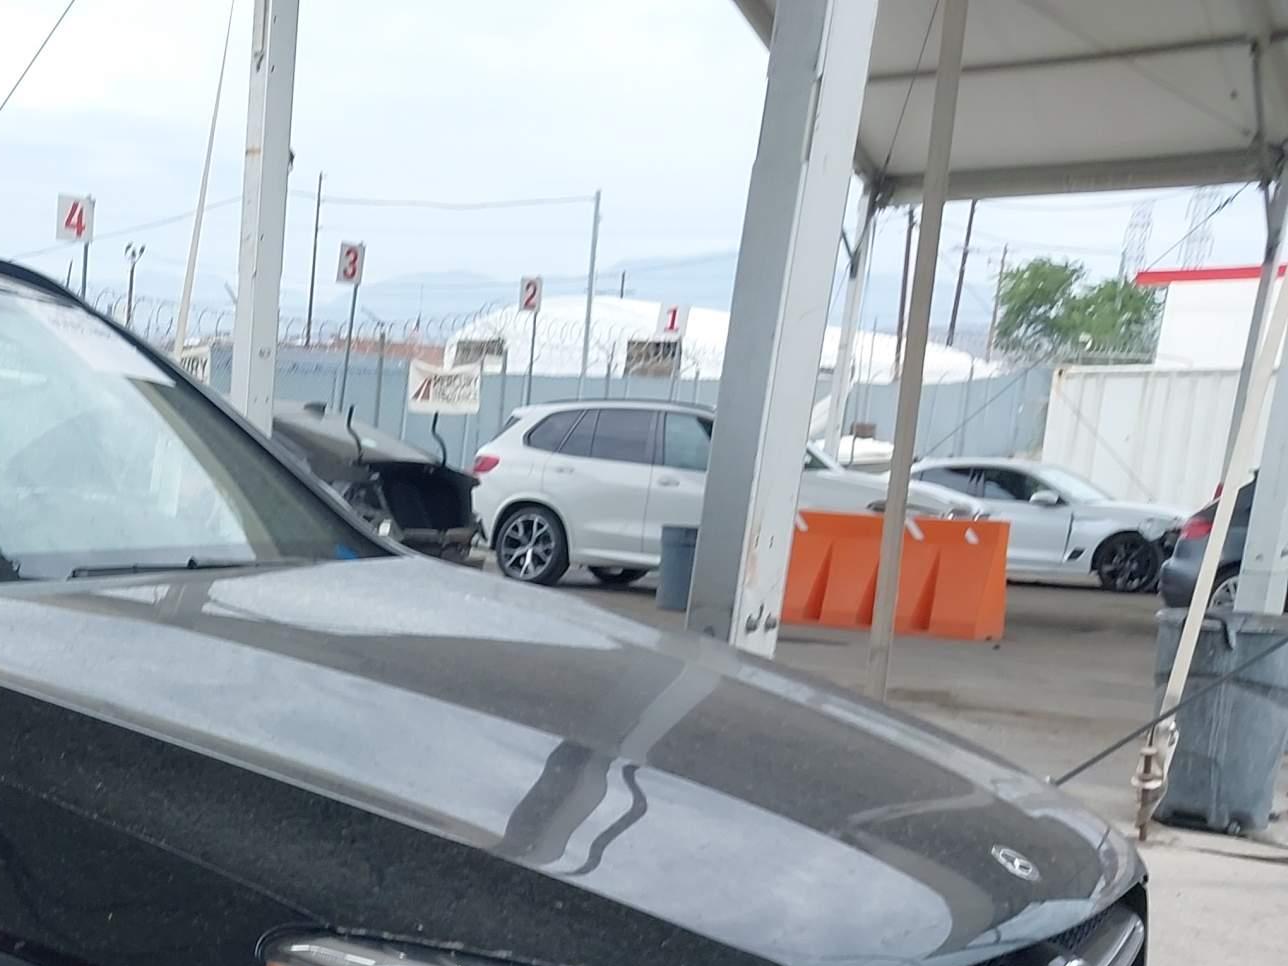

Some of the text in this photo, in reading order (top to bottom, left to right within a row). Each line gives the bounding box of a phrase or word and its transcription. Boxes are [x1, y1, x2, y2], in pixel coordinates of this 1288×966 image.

[65, 202, 86, 238] 4
[342, 247, 359, 280] 3
[523, 280, 539, 310] 2
[664, 306, 679, 333] 1
